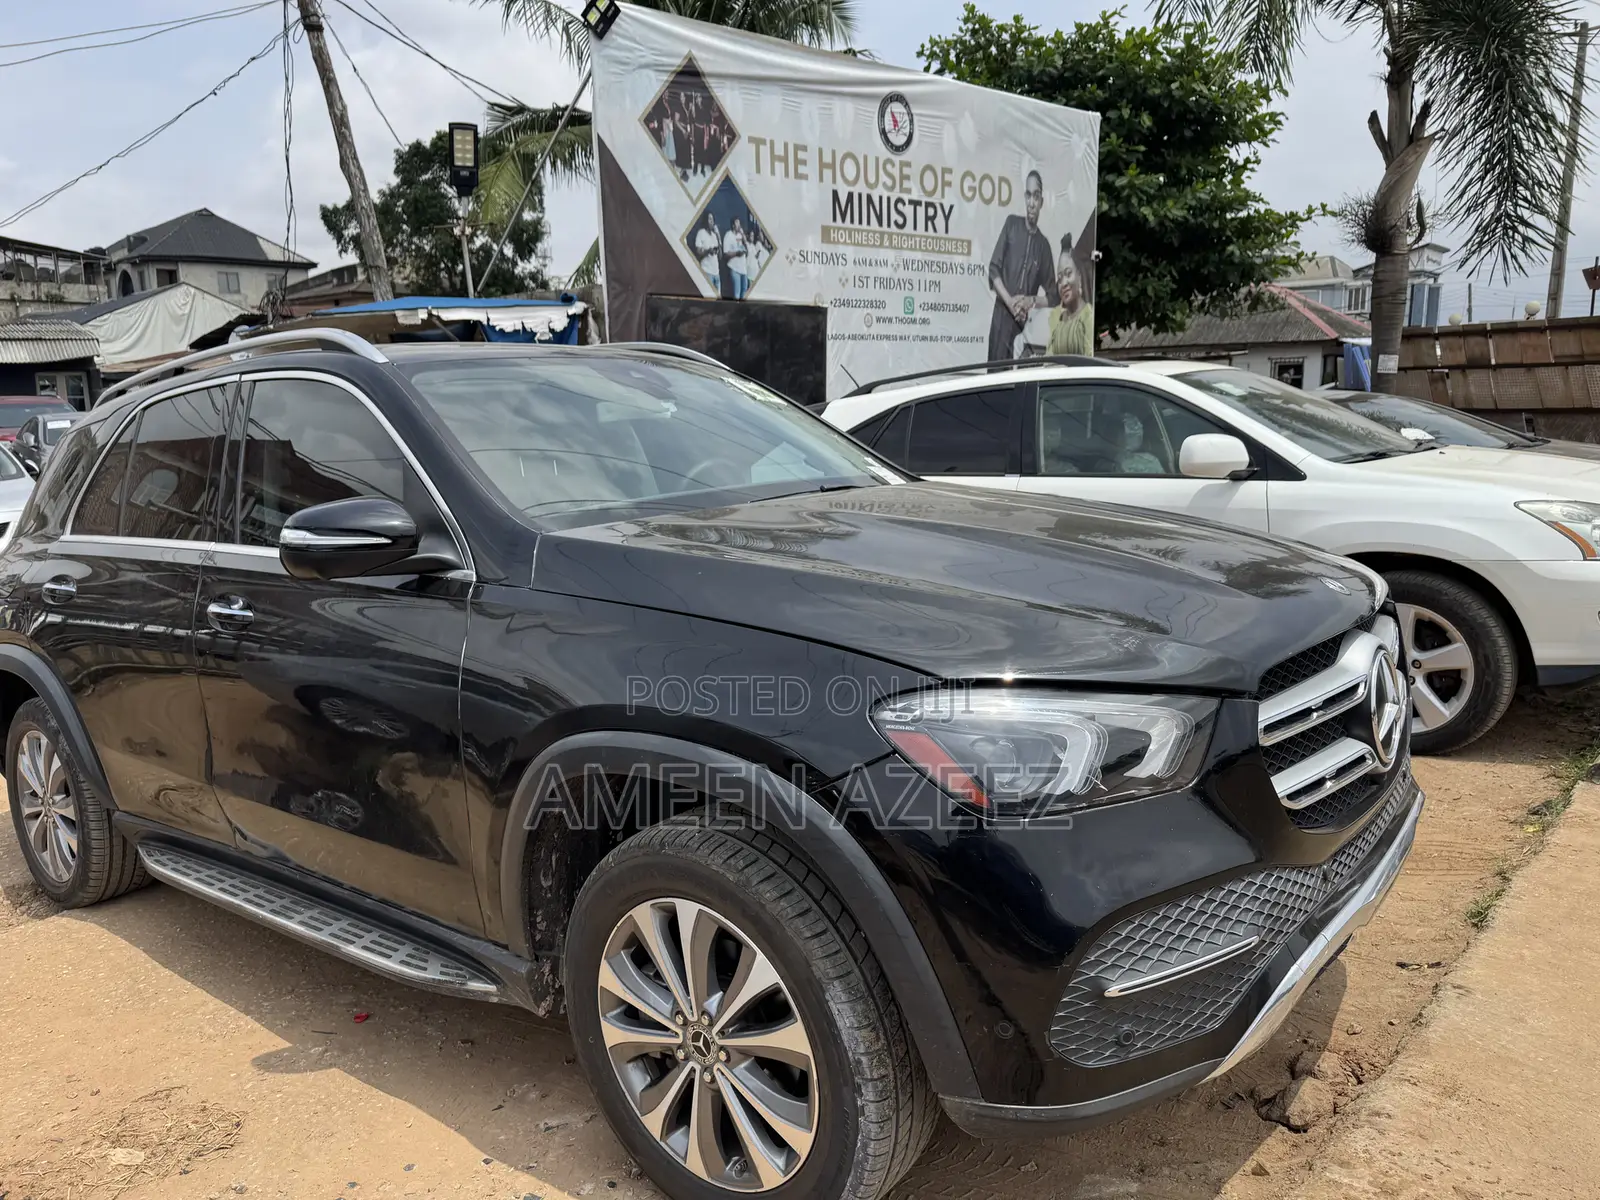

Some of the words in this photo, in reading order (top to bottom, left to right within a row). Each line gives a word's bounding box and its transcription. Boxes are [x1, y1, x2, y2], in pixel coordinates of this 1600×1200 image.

[747, 135, 809, 181] THE
[817, 146, 912, 195] HOUSE
[919, 163, 953, 199] OF
[959, 169, 1013, 208] GOD
[831, 189, 955, 235] MINISTRY
[830, 229, 881, 246] HOLINESS
[883, 235, 890, 244] &
[892, 235, 968, 254] RIGHTEOUSNESS
[799, 250, 848, 267] SUNDAYS
[902, 258, 965, 275] WEDNESDAYS
[967, 264, 986, 277] 6PM
[852, 275, 871, 289] 1ST
[873, 277, 914, 291] FRIDAYS
[918, 278, 941, 293] 11PM
[829, 299, 887, 310] +2349122328320
[918, 303, 970, 314] +2348057135407
[875, 315, 931, 326] WWW.THOGMI.ORG
[875, 334, 898, 342] EXPRESS
[954, 335, 970, 344] LAGOS
